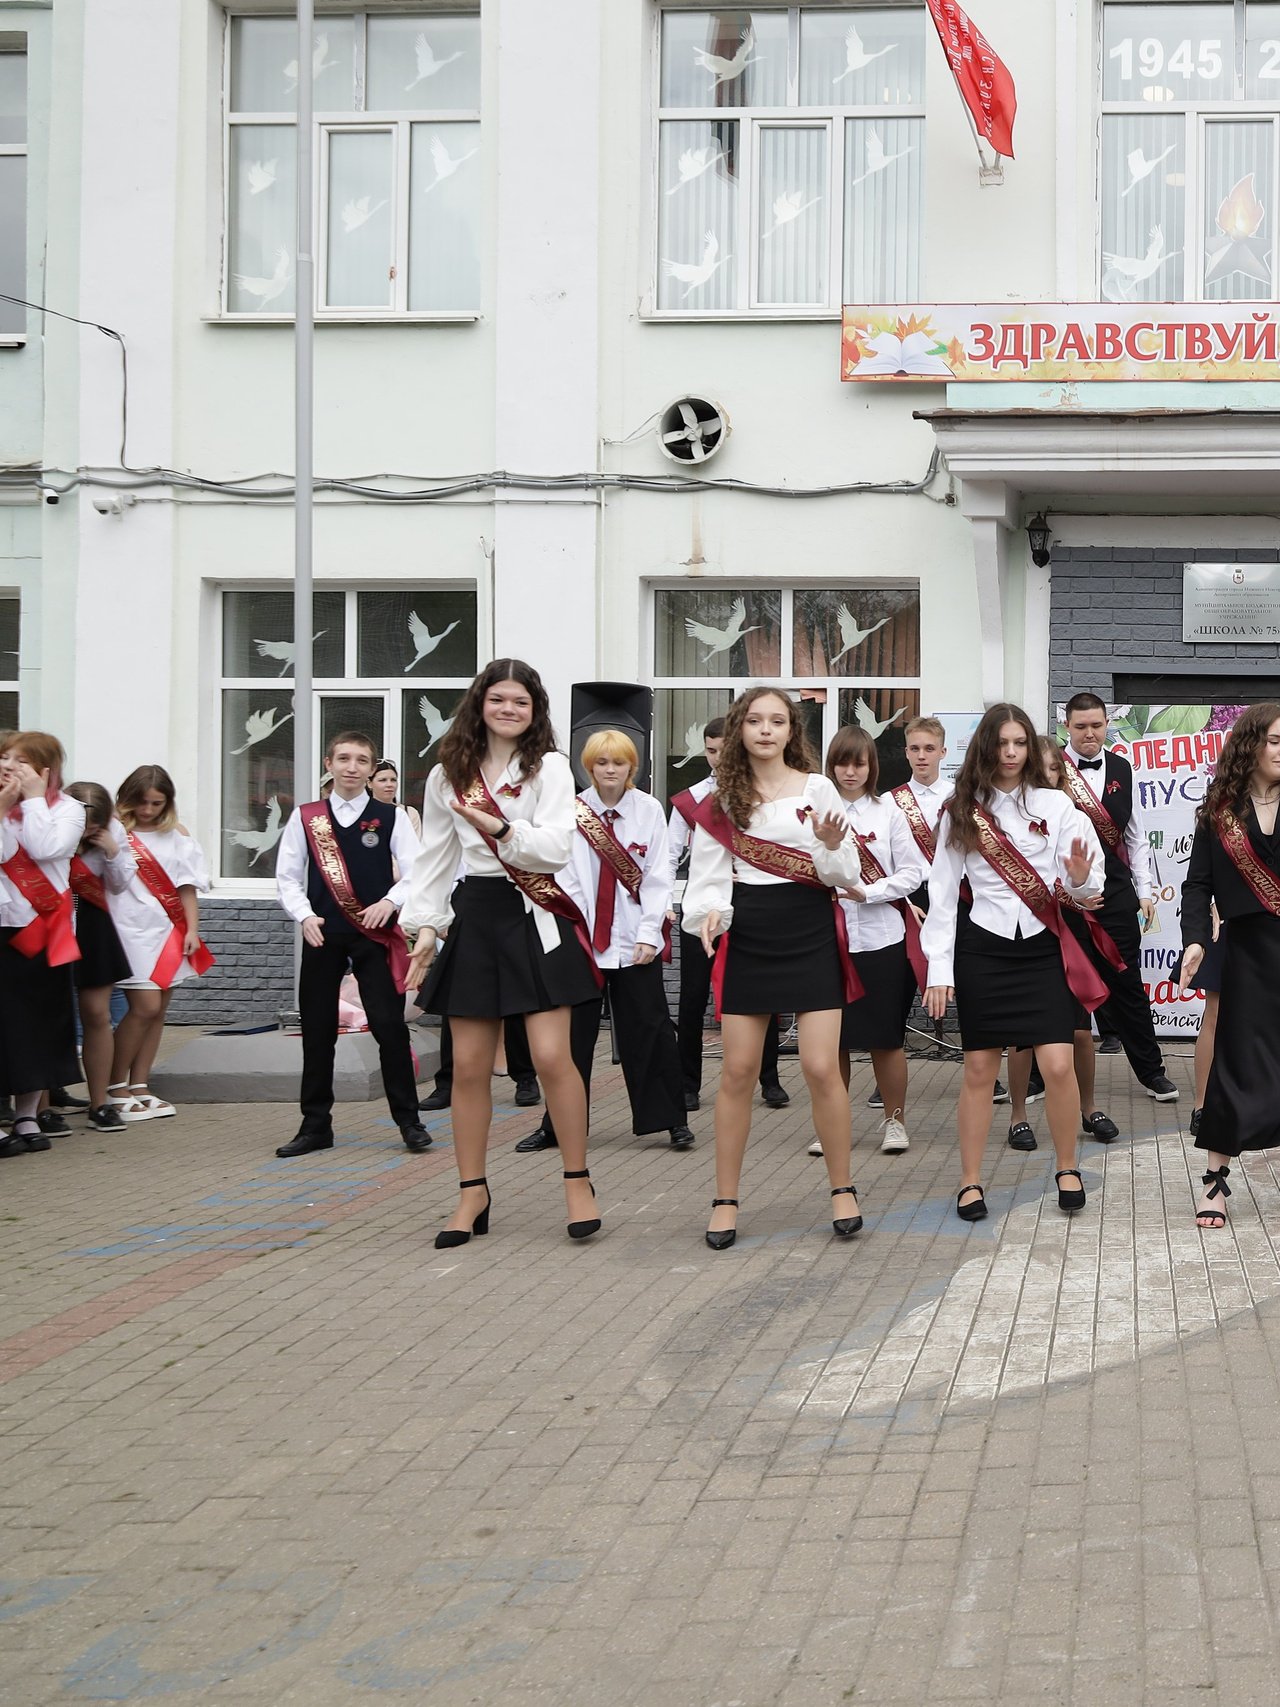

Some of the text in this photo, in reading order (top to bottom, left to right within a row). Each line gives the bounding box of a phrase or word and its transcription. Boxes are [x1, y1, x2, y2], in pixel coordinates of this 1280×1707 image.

[1109, 37, 1223, 80] 1945
[1194, 626, 1246, 635] «ШКОЛА
[1249, 626, 1263, 635] №
[1138, 776, 1211, 809] ПУС
[1227, 830, 1280, 900] Выпускник
[1014, 875, 1052, 912] 2025
